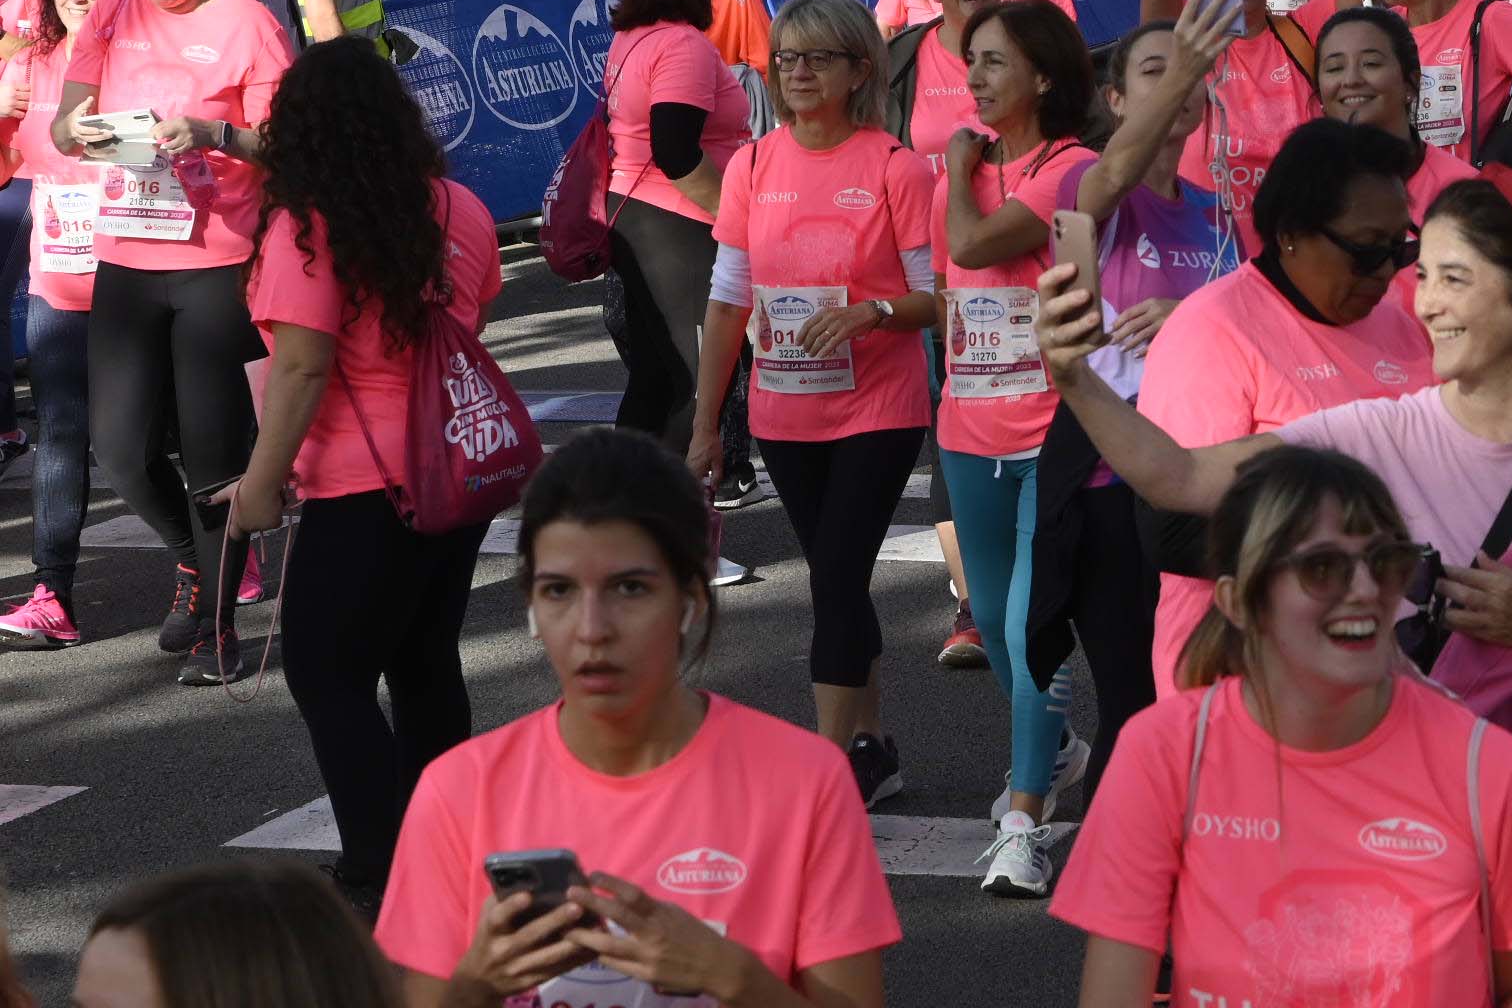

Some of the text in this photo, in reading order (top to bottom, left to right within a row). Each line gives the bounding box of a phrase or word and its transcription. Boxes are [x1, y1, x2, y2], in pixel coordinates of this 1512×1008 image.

[482, 57, 574, 104] ASTURIANA
[925, 86, 967, 97] OYSHO
[128, 180, 160, 194] 016
[129, 197, 155, 207] 21876
[757, 191, 798, 205] OYSHO
[62, 220, 93, 232] 016
[153, 223, 187, 233] Santander
[770, 305, 811, 315] ASTURIANA
[774, 330, 795, 345] 01
[968, 331, 1001, 347] 016
[971, 351, 997, 361] 31270
[808, 376, 844, 385] Santander
[1000, 376, 1038, 387] Santander
[1193, 812, 1281, 842] OYSHO
[1368, 829, 1440, 853] ASTURIANA
[666, 865, 741, 884] ASTURIANA
